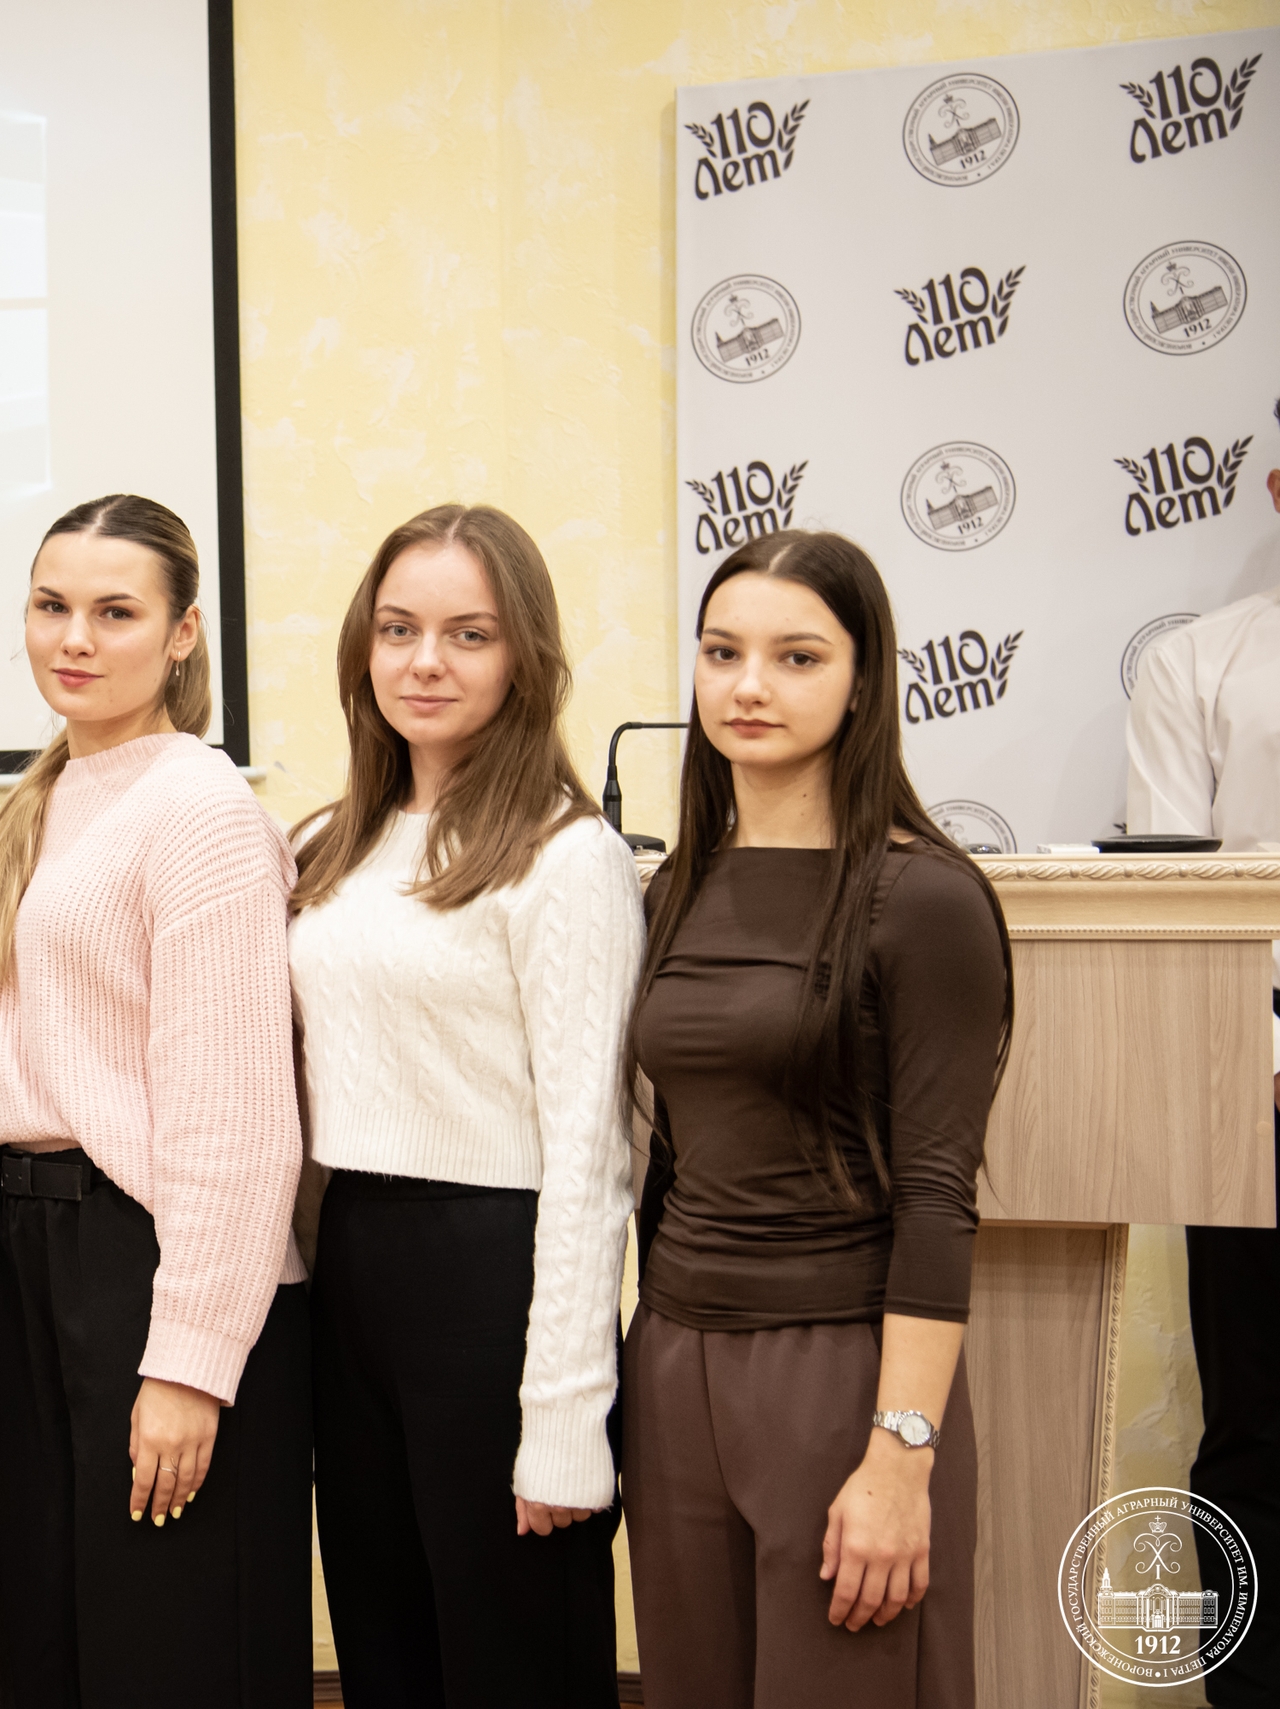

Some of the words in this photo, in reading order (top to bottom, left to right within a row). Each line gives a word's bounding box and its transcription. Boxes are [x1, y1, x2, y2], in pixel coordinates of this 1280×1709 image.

[1147, 57, 1223, 121] 110
[710, 101, 775, 160] 110
[960, 149, 987, 169] 1912
[921, 266, 989, 326] 110
[1183, 318, 1212, 338] 1912
[711, 460, 775, 517] 110
[1142, 436, 1216, 496] 110
[921, 630, 989, 686] 110
